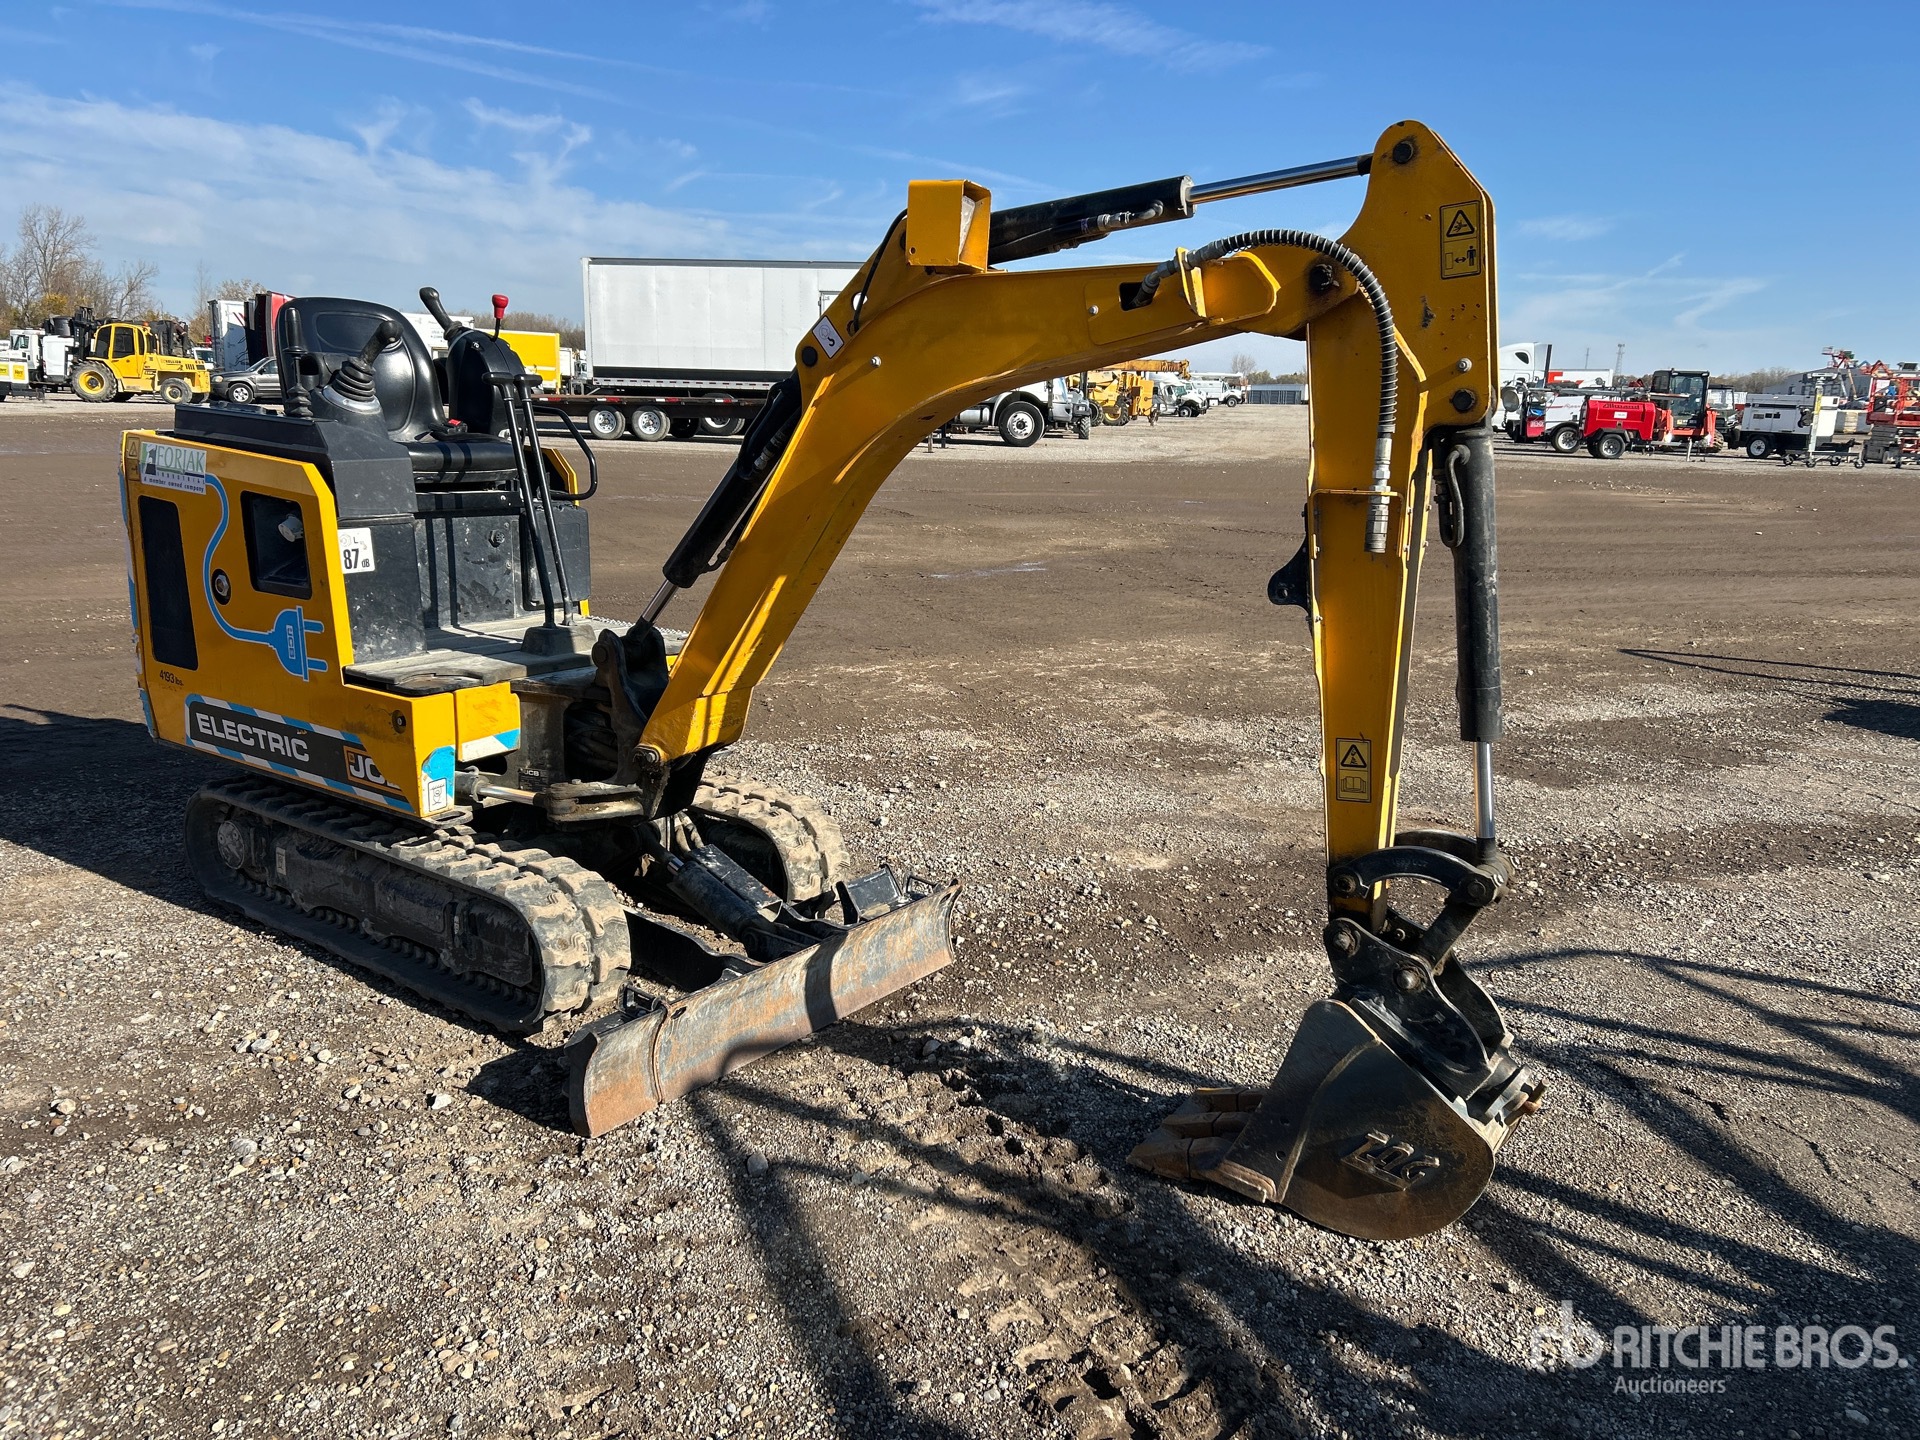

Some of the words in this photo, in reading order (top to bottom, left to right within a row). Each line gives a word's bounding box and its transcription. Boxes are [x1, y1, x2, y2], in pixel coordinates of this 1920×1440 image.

[156, 445, 205, 474] FORJAK
[184, 484, 204, 493] company
[343, 548, 359, 570] 87
[285, 624, 296, 660] JCB
[159, 669, 175, 684] 4193
[195, 712, 310, 762] ELECTRIC
[349, 754, 401, 790] JC
[524, 769, 540, 777] JCB
